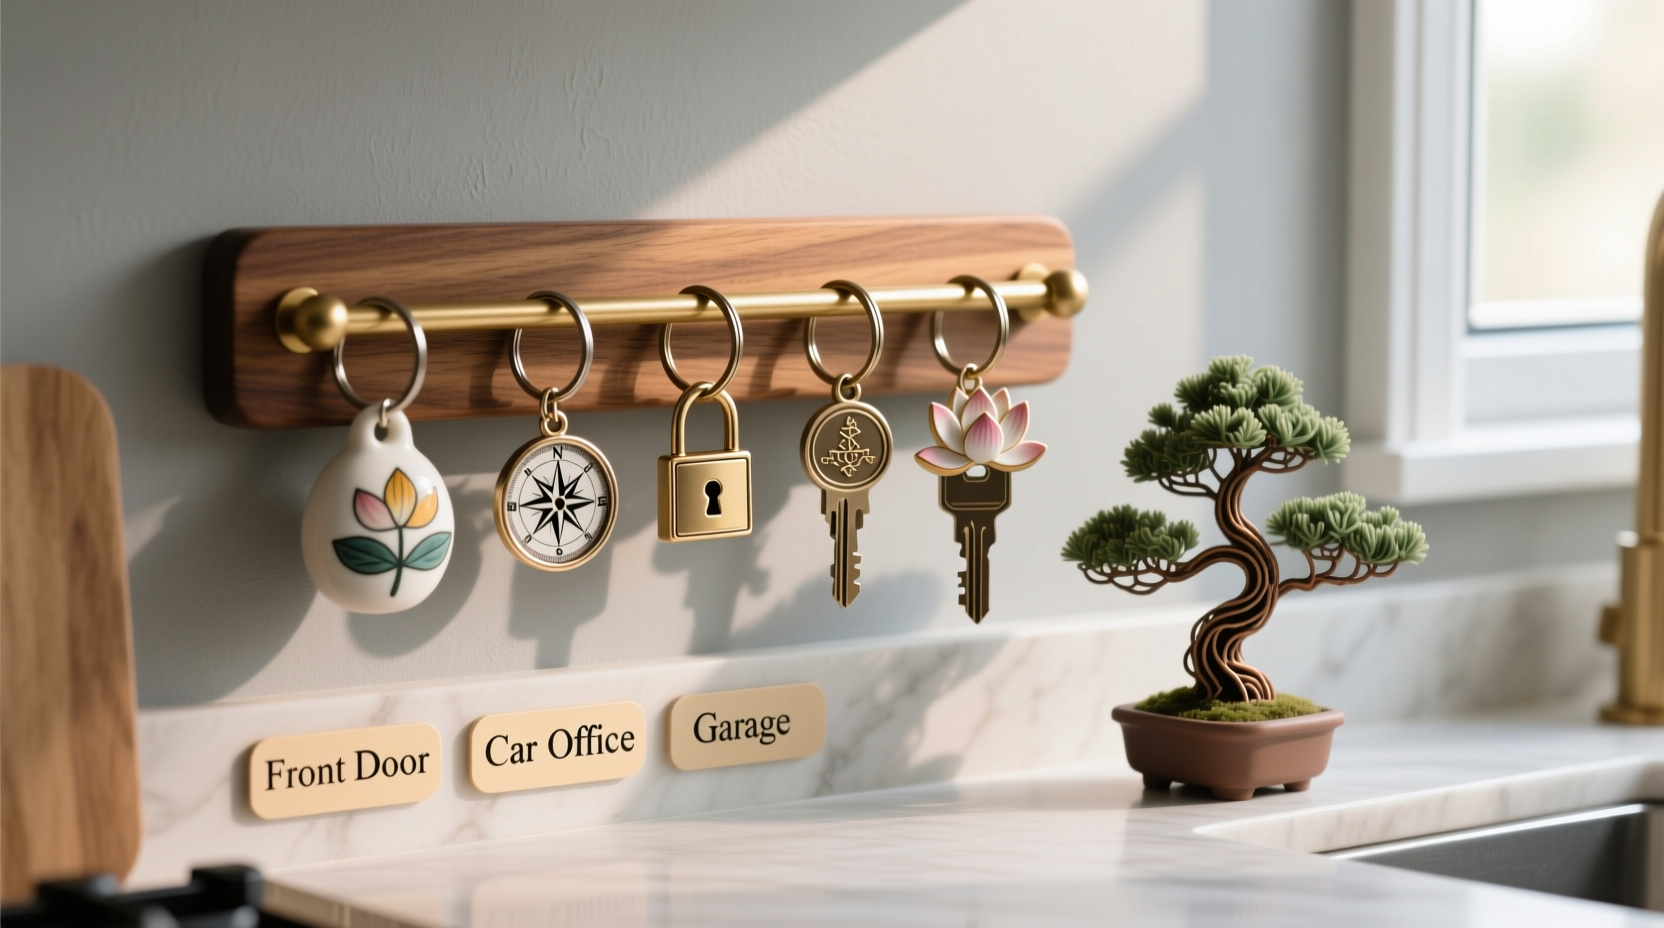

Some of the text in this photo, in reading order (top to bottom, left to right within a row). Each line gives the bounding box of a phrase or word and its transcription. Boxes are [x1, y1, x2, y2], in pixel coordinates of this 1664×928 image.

[553, 445, 563, 459] N
[485, 723, 635, 767] Car Office
[693, 711, 791, 746] Garage
[266, 749, 430, 791] Front Door
